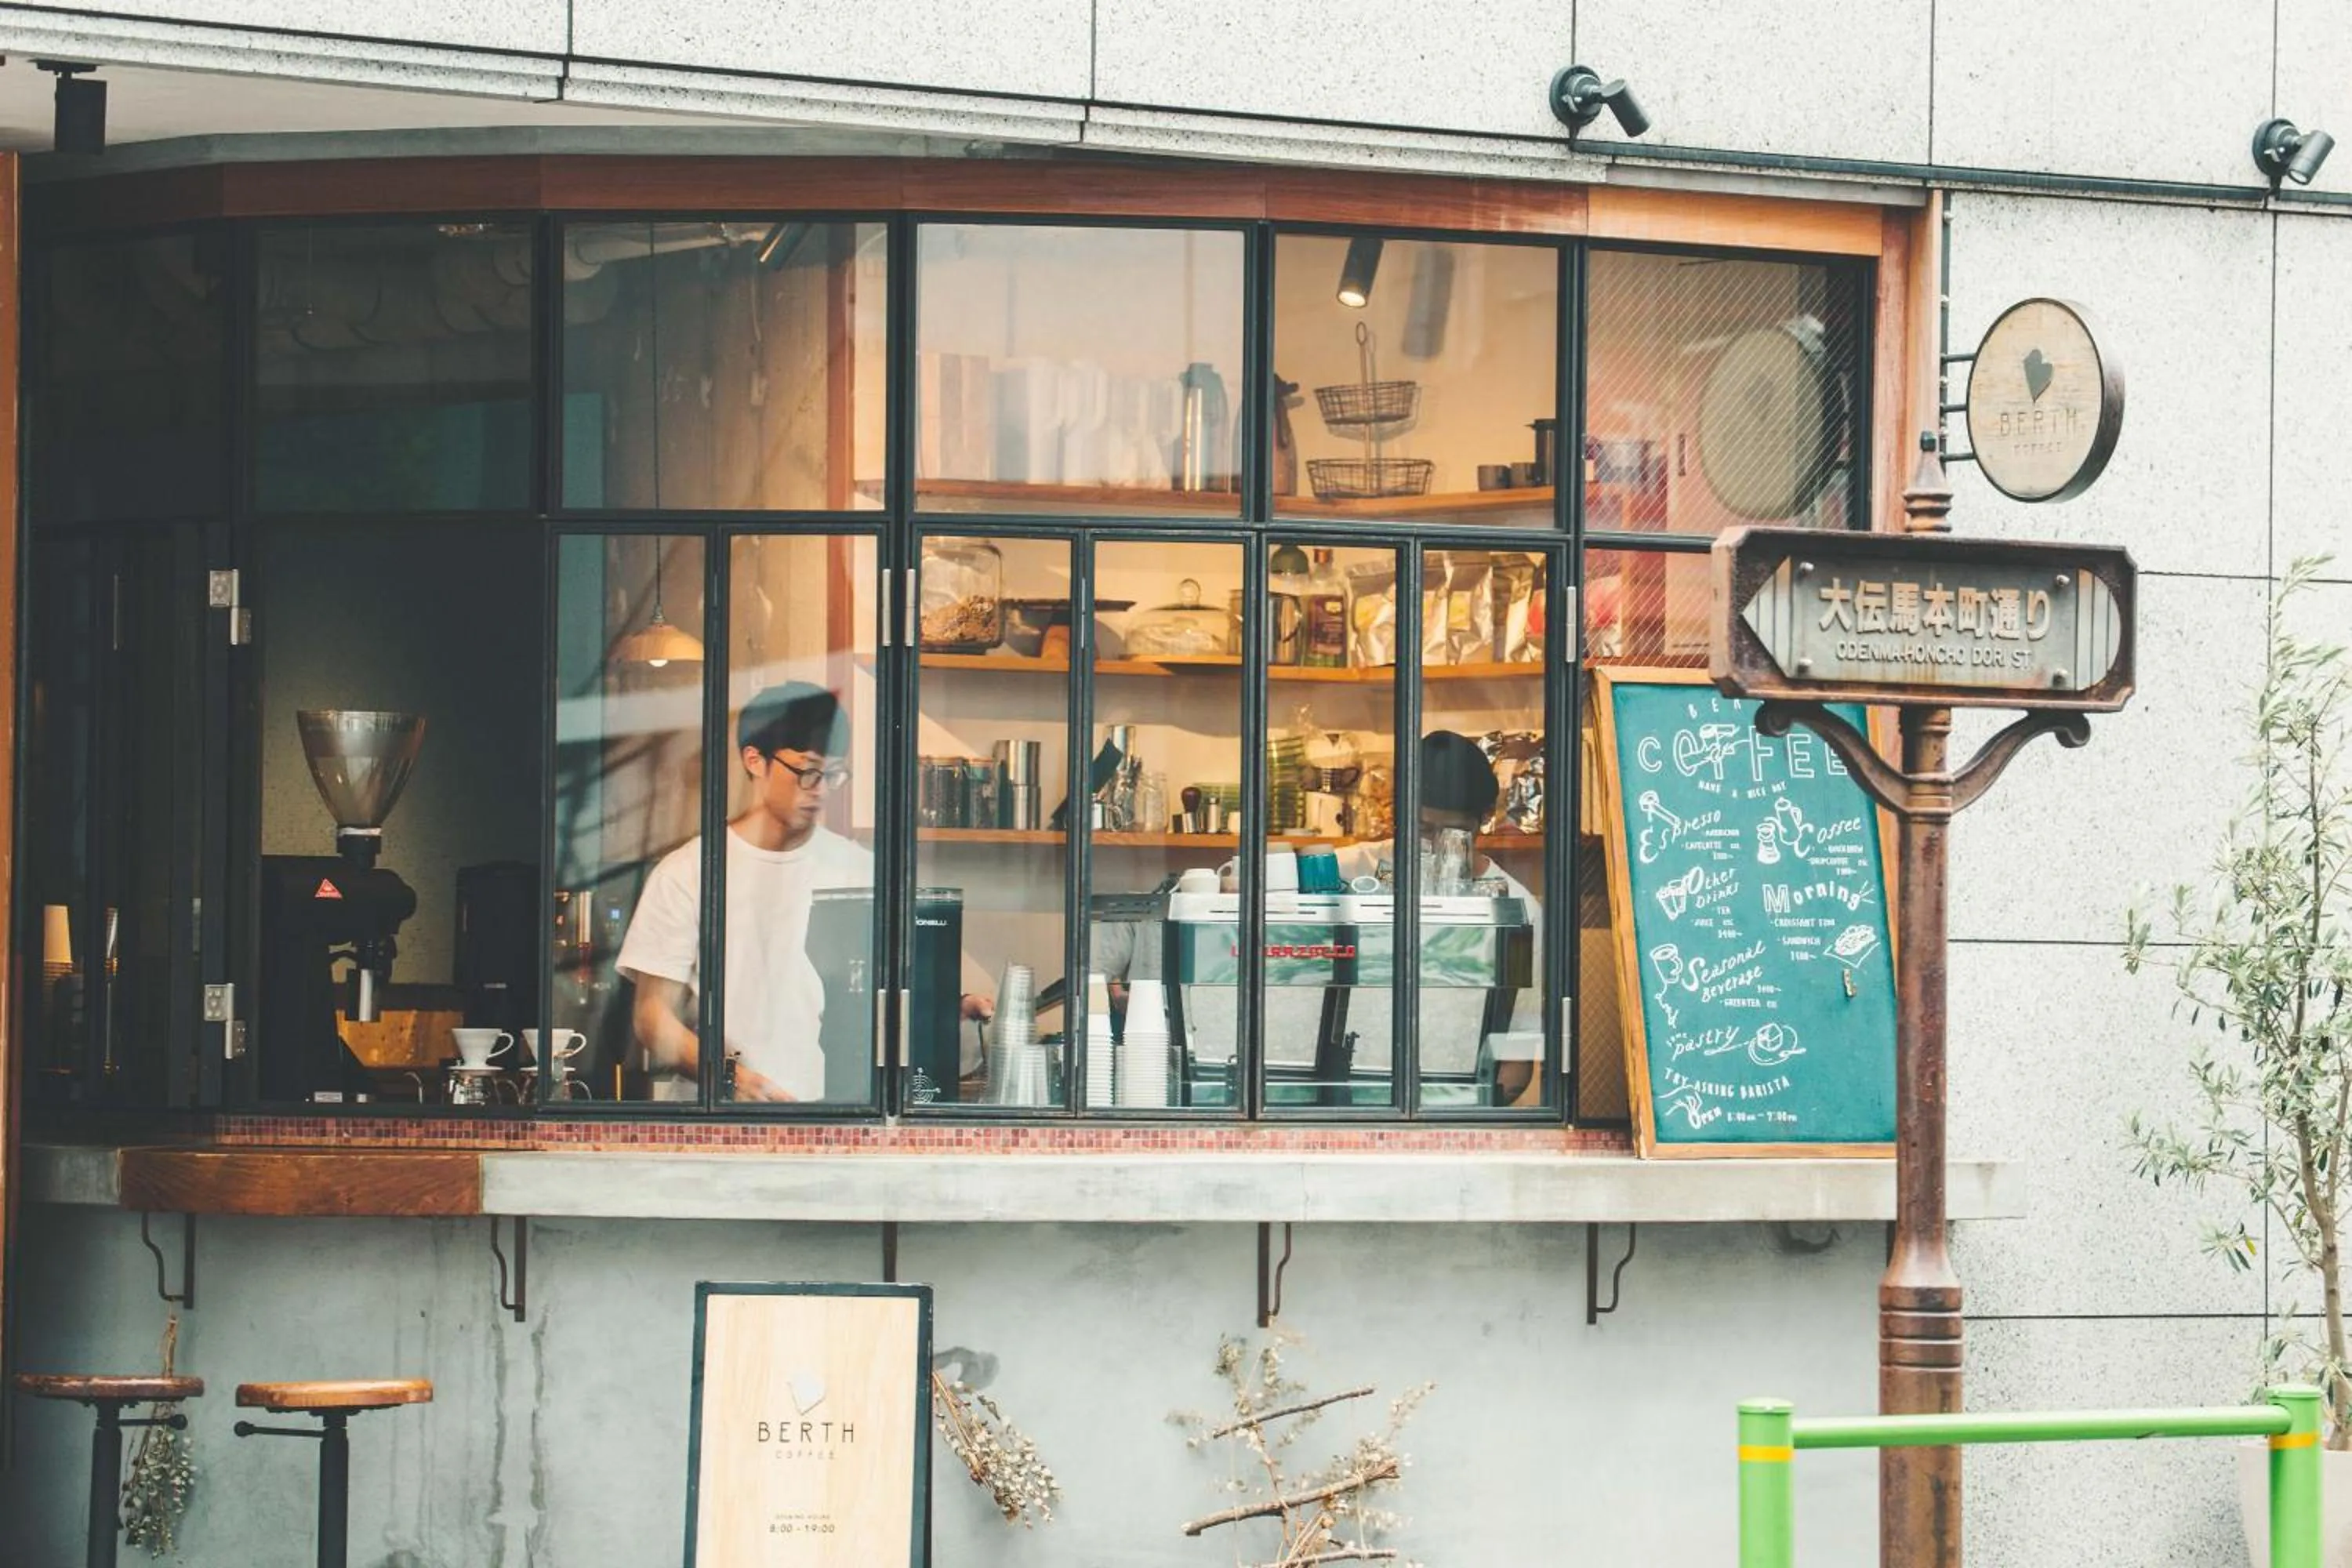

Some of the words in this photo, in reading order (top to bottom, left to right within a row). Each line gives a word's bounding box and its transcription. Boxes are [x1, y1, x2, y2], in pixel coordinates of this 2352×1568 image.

[1999, 407, 2078, 437] BERTH
[1818, 577, 2052, 641] 大伝馬本町通り
[1835, 642, 1965, 666] ODENMA-HONCHO
[1971, 647, 2007, 667] DORI
[1762, 880, 1860, 913] Morning
[1693, 1080, 1735, 1098] ASKING
[1739, 1075, 1791, 1100] BARISTA
[757, 1421, 855, 1443] BERTH
[769, 1523, 793, 1534] 8:00
[804, 1523, 836, 1534] 19:00
